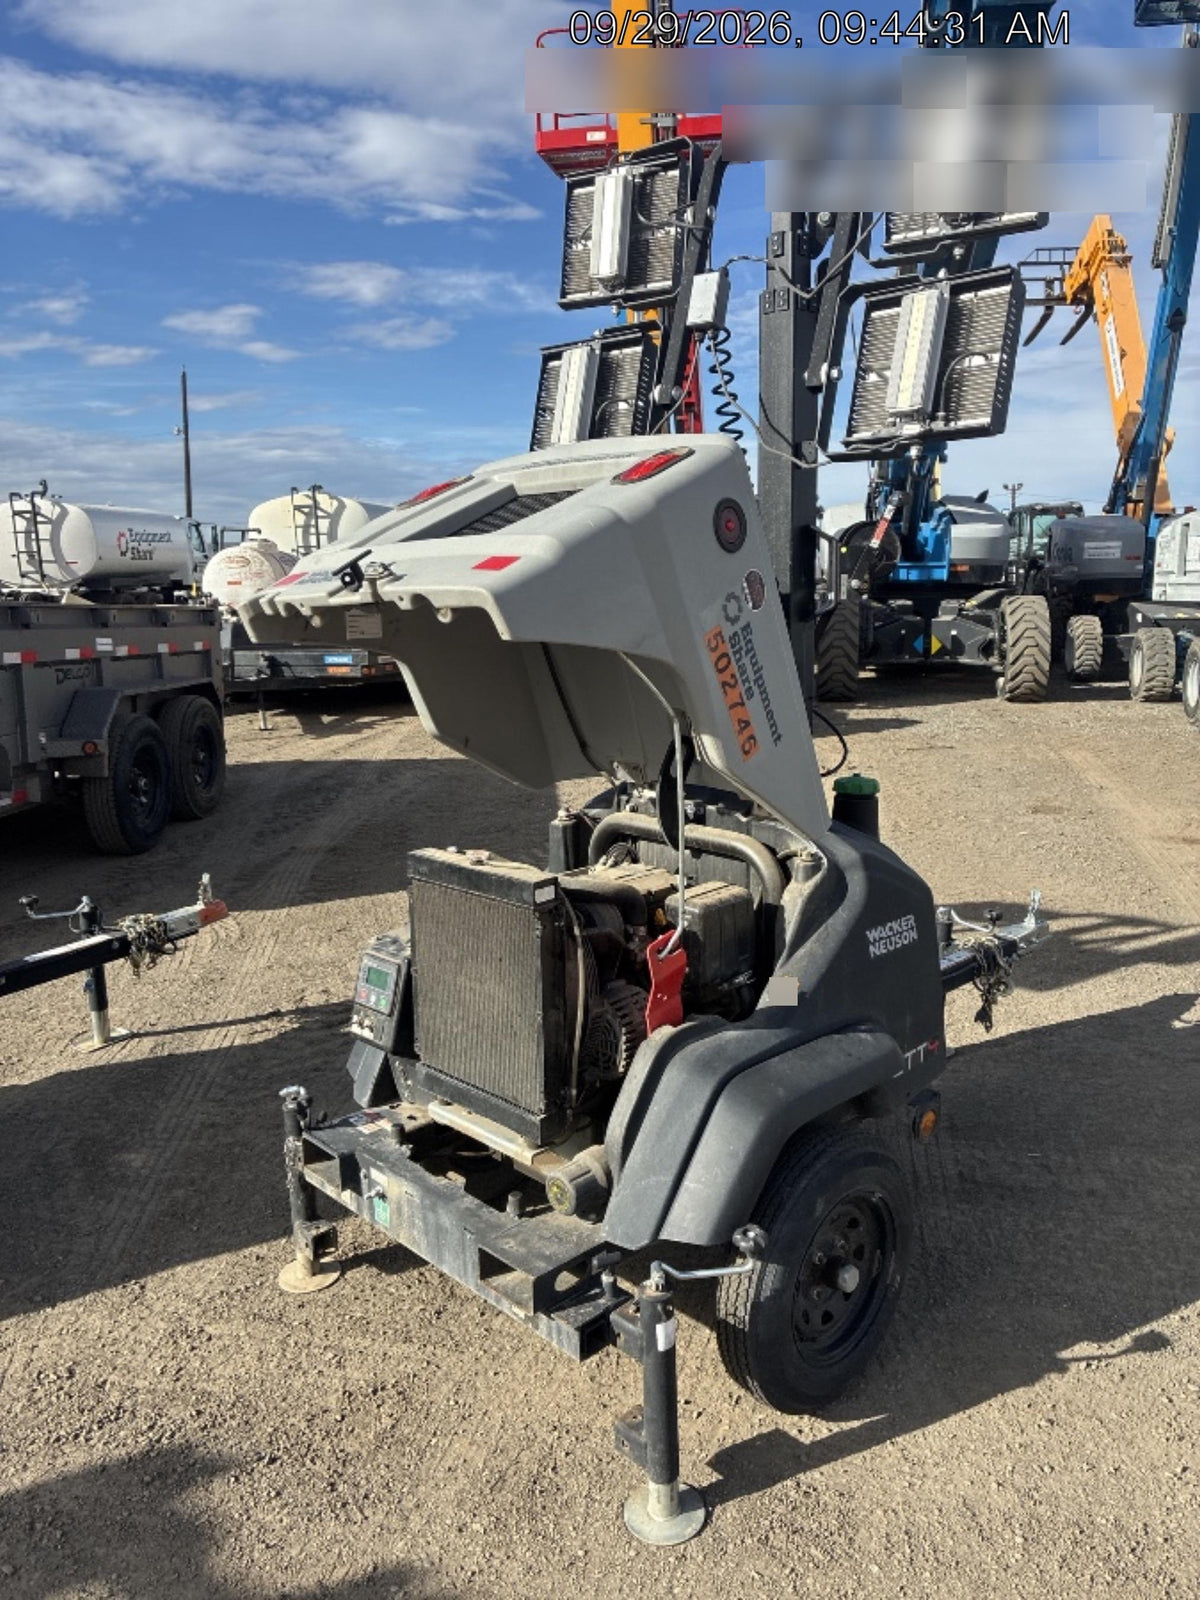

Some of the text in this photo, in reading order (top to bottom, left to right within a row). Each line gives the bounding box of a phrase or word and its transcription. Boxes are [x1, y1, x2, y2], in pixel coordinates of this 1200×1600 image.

[706, 630, 757, 756] 502746
[728, 630, 755, 702] Share
[739, 621, 783, 747] Equipment
[866, 914, 916, 943] WACKER
[868, 927, 919, 958] NEUSON
